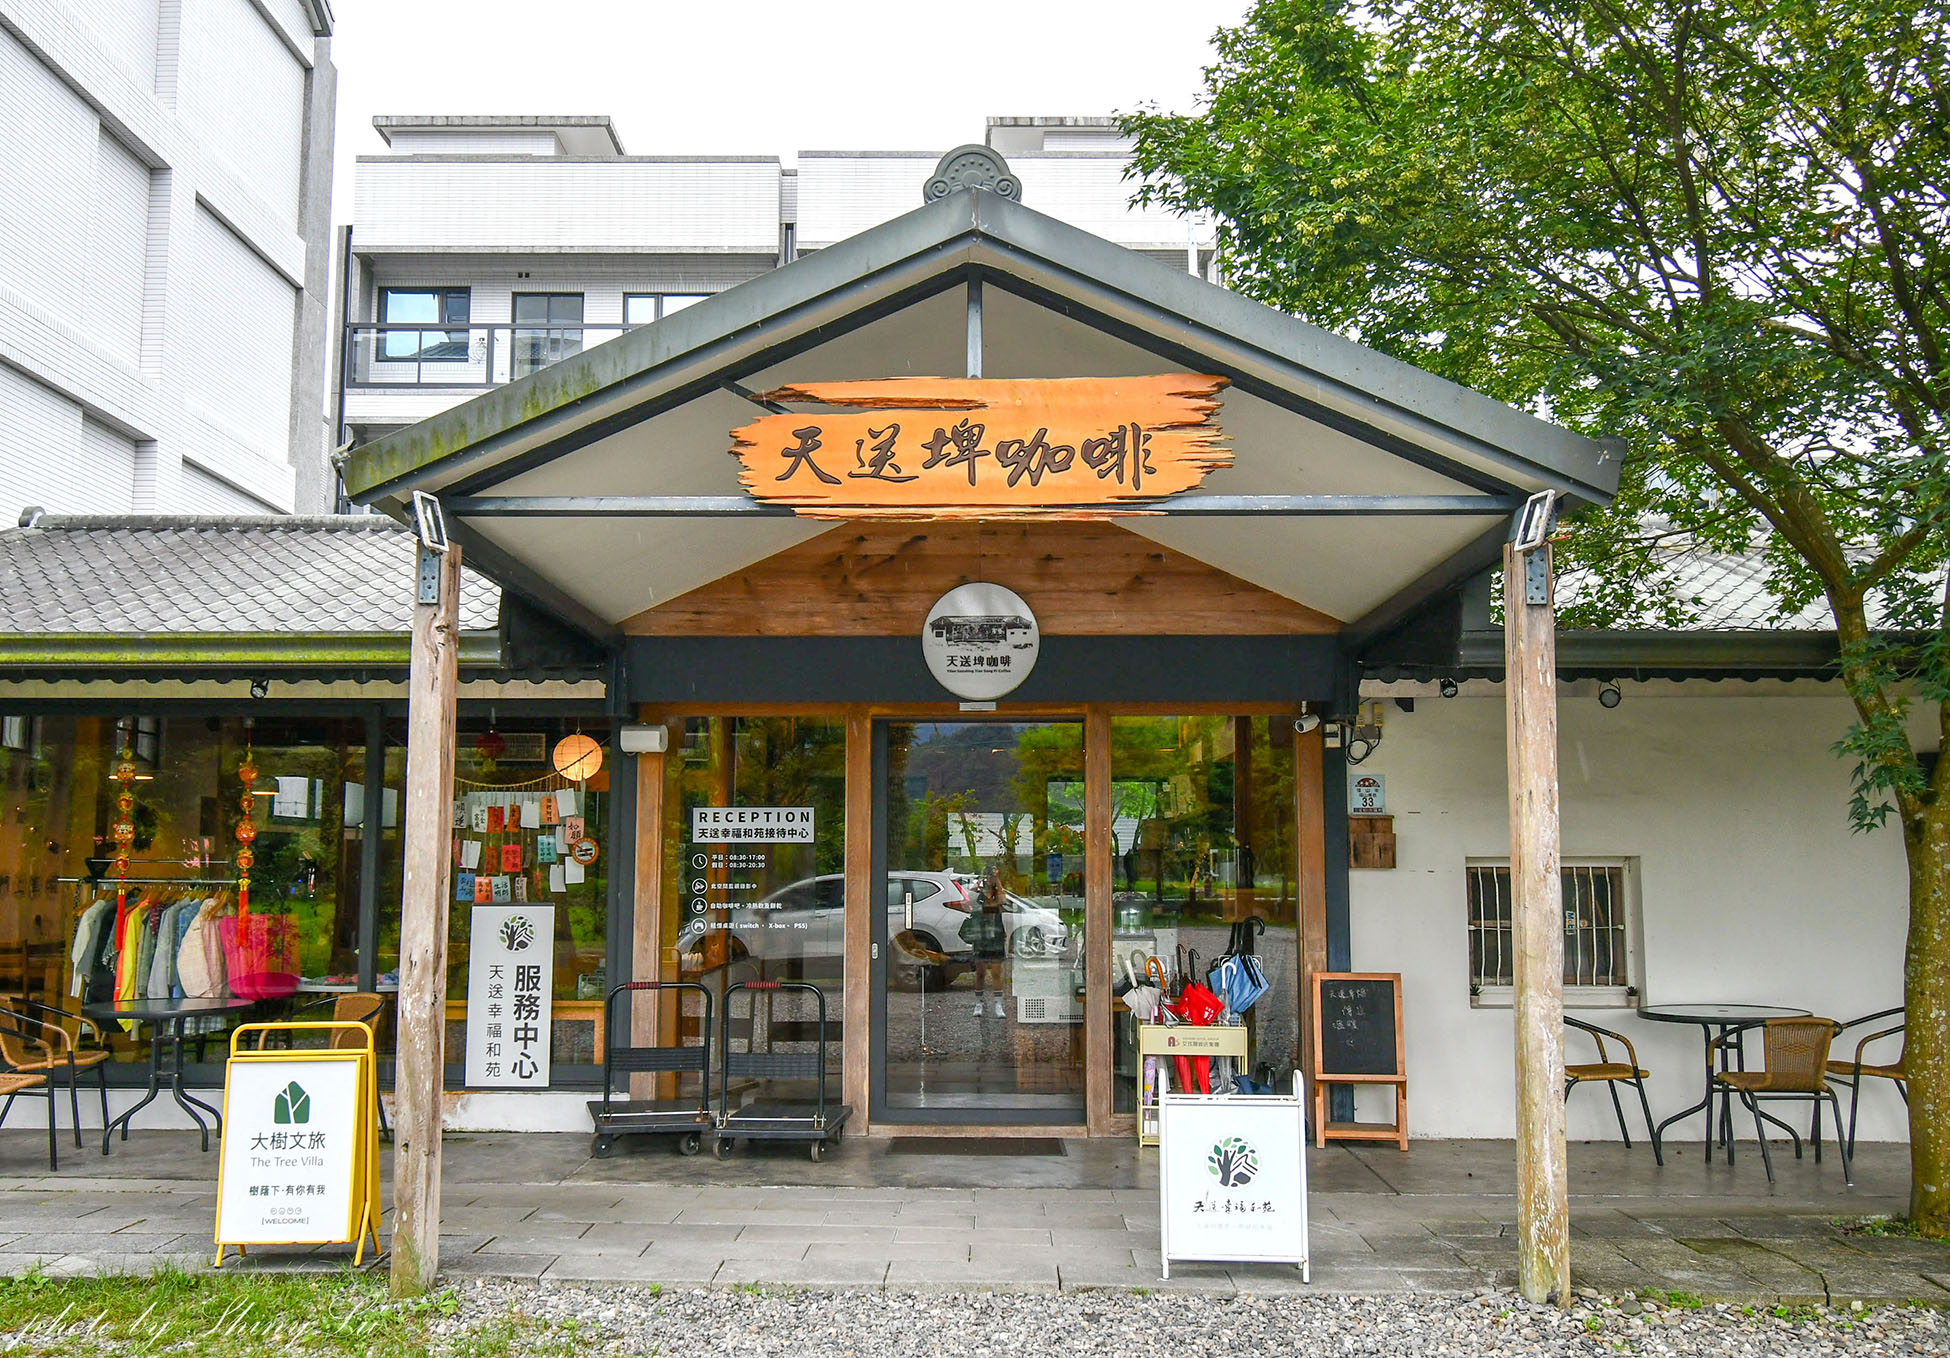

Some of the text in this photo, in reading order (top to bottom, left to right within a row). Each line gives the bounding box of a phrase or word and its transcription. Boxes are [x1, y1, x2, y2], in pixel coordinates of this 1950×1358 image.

[775, 418, 1157, 491] 天送埤咖啡
[946, 655, 1012, 667] 天送埤咖啡
[1362, 797, 1374, 807] 33
[699, 812, 810, 823] RECEPTION
[698, 828, 809, 839] 天送幸福和苑接待中心
[485, 965, 504, 1078] 天送幸福和苑
[511, 965, 541, 1079] 服務中心
[250, 1131, 326, 1150] 大樹文旅
[250, 1156, 324, 1167] The Tree Villa
